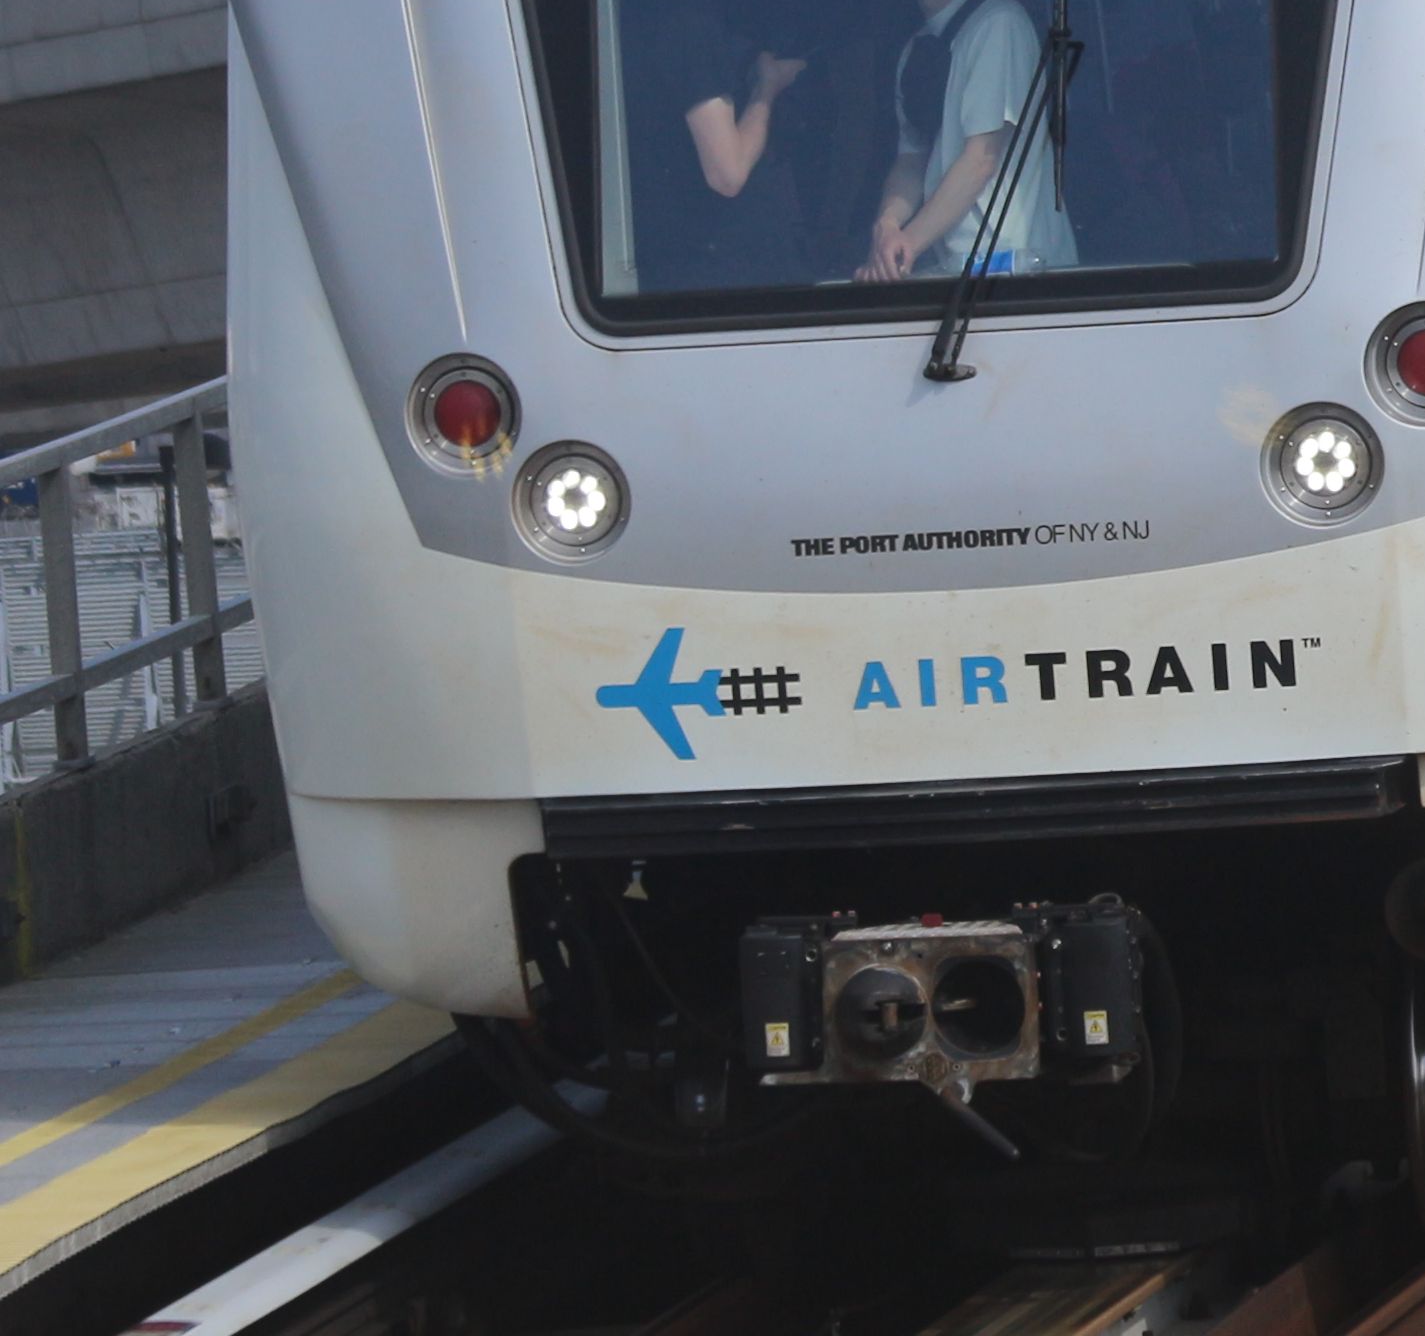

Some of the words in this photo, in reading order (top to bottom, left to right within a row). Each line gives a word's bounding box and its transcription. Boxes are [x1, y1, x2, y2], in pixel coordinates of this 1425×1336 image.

[790, 538, 836, 557] THE
[839, 533, 900, 555] PORT
[902, 526, 1032, 553] AUTHORITY
[1034, 523, 1067, 545] OF
[1069, 521, 1100, 544] NY
[1103, 521, 1119, 541] &
[1122, 519, 1150, 540] NJ
[853, 638, 1298, 711] AIRTRAIN
